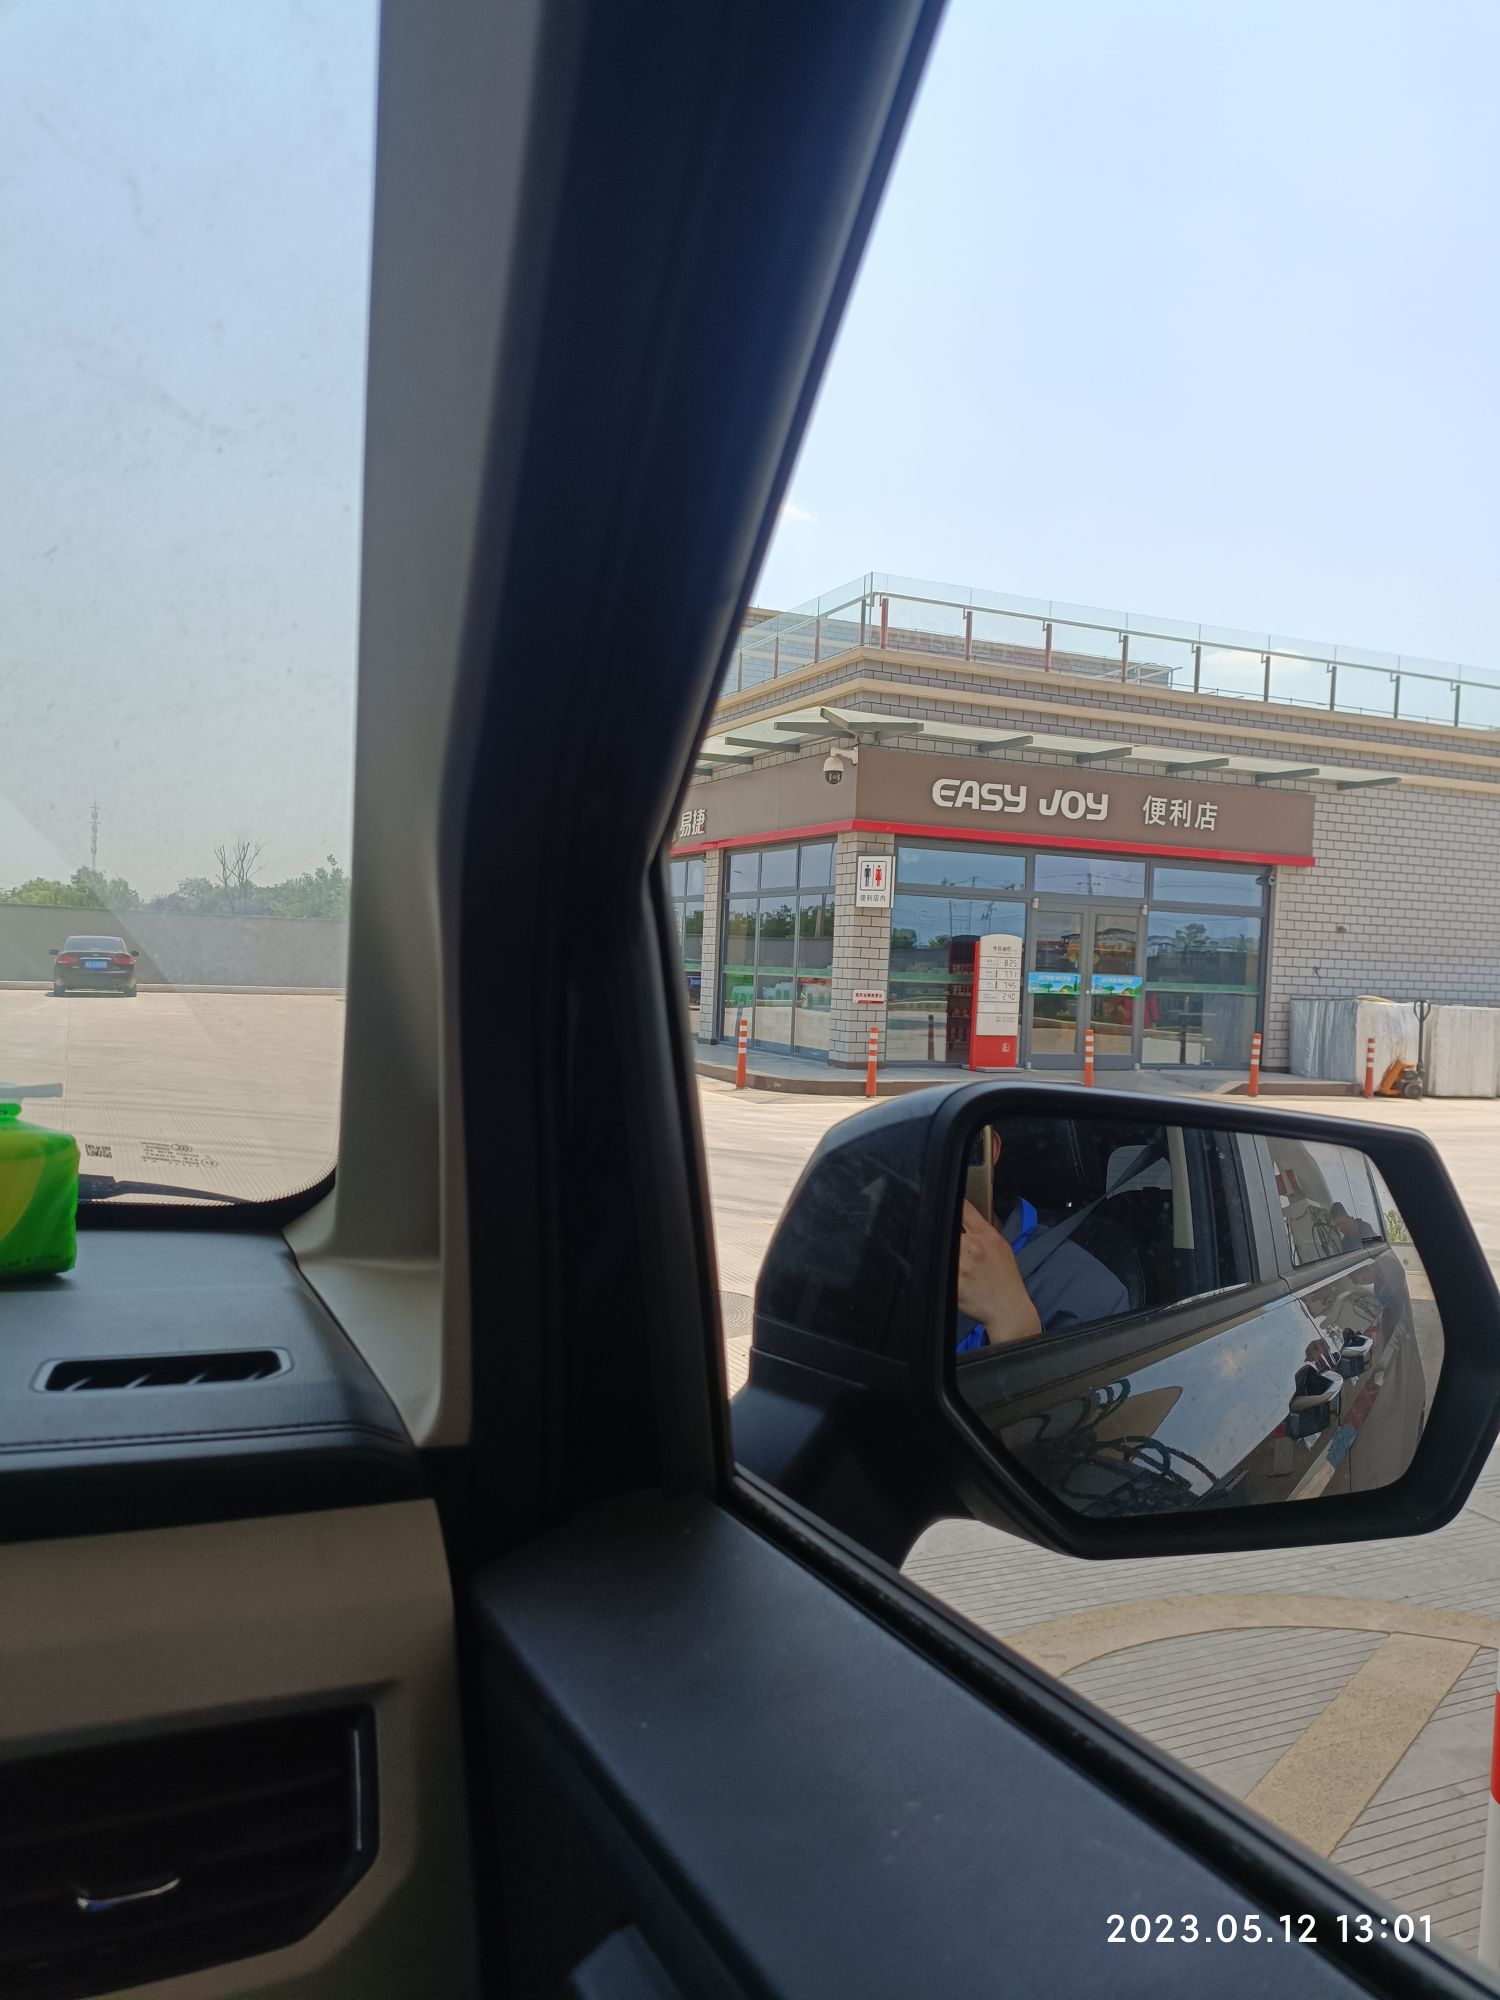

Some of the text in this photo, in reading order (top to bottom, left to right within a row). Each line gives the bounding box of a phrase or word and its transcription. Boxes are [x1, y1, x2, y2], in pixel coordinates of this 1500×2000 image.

[932, 778, 1109, 821] EASY JOY
[1143, 794, 1218, 830] 便利店
[680, 808, 705, 837] 易捷
[860, 894, 886, 902] 便利店内
